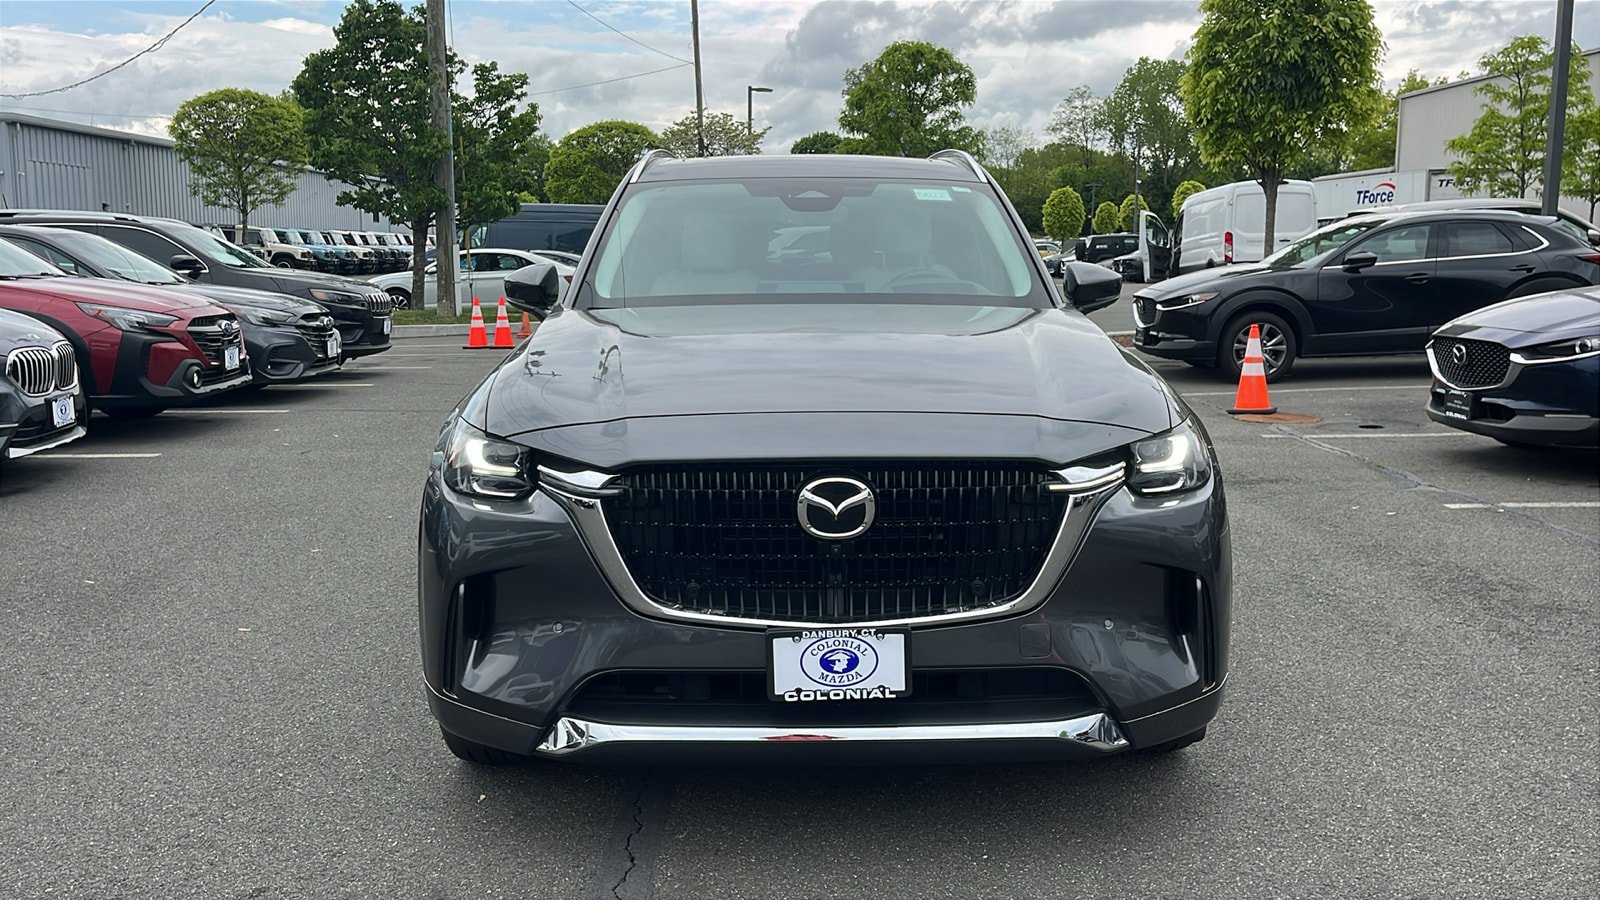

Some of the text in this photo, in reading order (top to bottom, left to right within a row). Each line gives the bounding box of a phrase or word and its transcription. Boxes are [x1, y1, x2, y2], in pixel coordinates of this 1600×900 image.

[1356, 190, 1394, 205] TForce
[861, 629, 876, 637] CT
[810, 639, 868, 657] COLONIAL
[817, 671, 863, 684] MAZDA
[784, 688, 896, 702] COLONIAL
